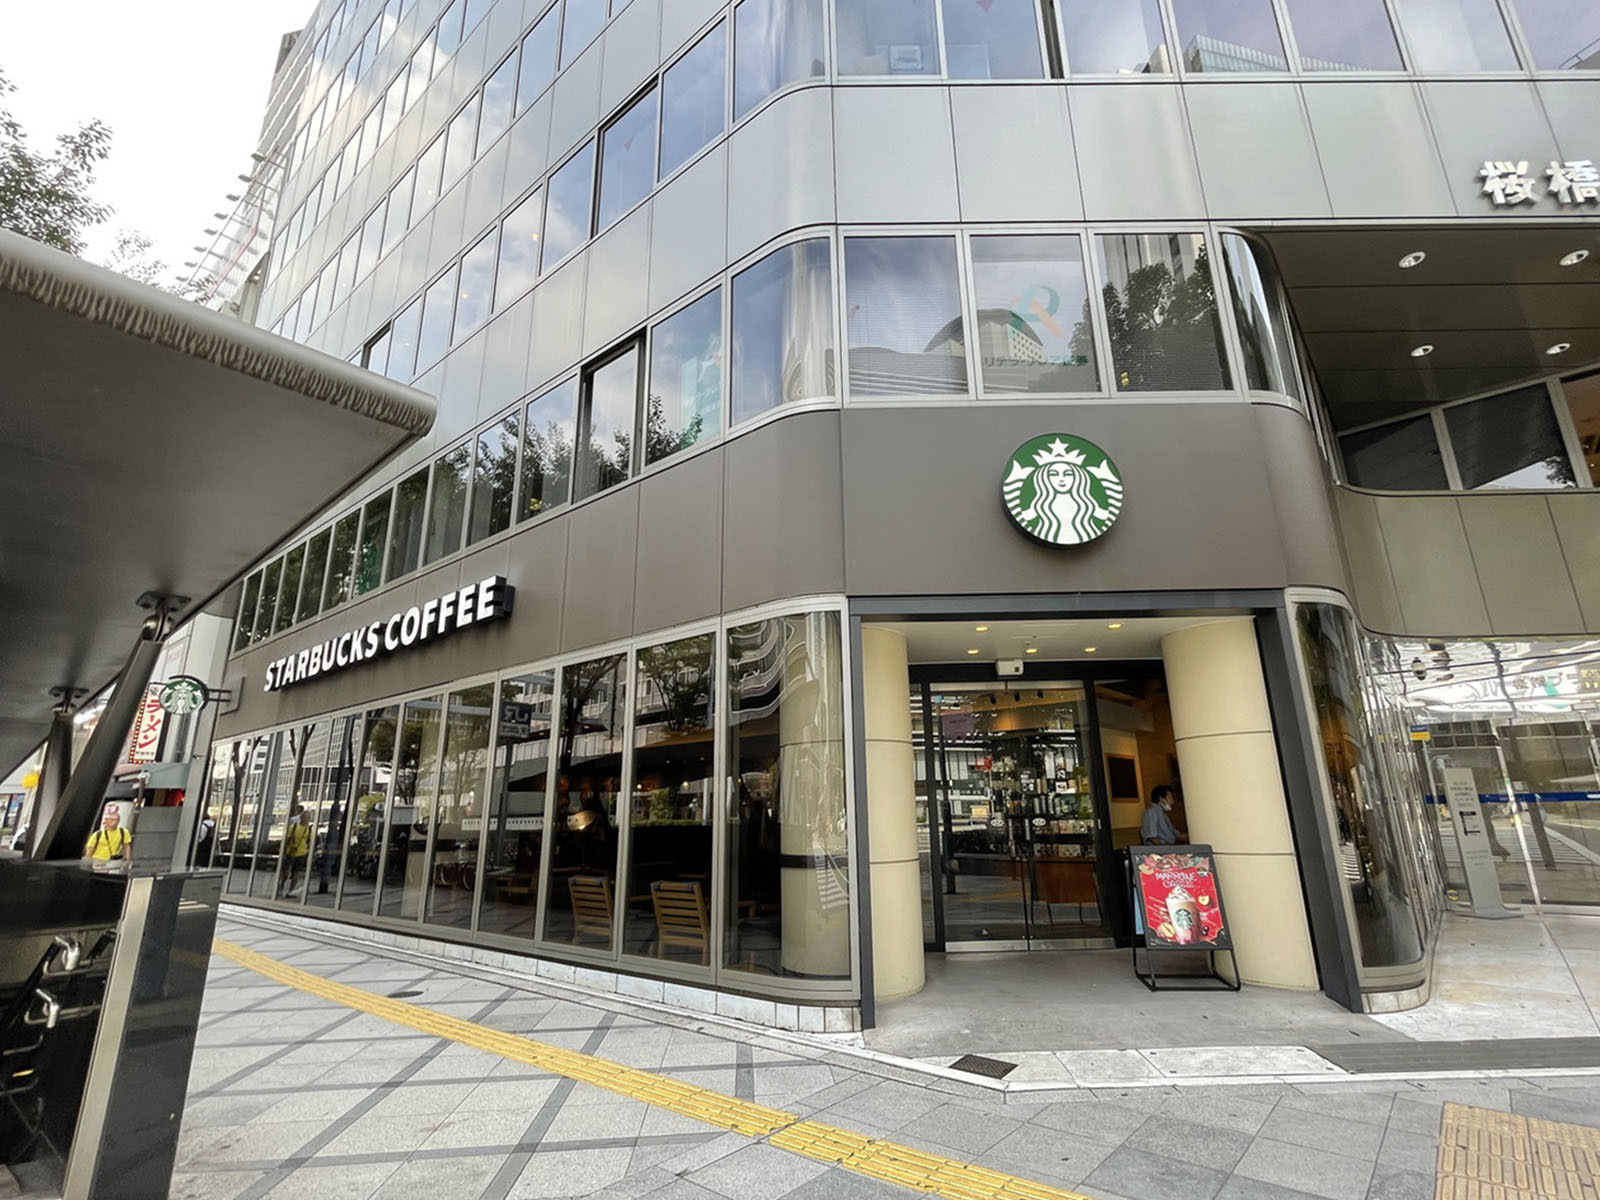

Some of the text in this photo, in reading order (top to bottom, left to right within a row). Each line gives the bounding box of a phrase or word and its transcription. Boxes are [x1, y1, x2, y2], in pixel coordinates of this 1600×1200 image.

[1480, 160, 1600, 205] 桜橋
[264, 575, 497, 692] STARBUCKS COFFEE
[139, 700, 163, 748] ラーメン
